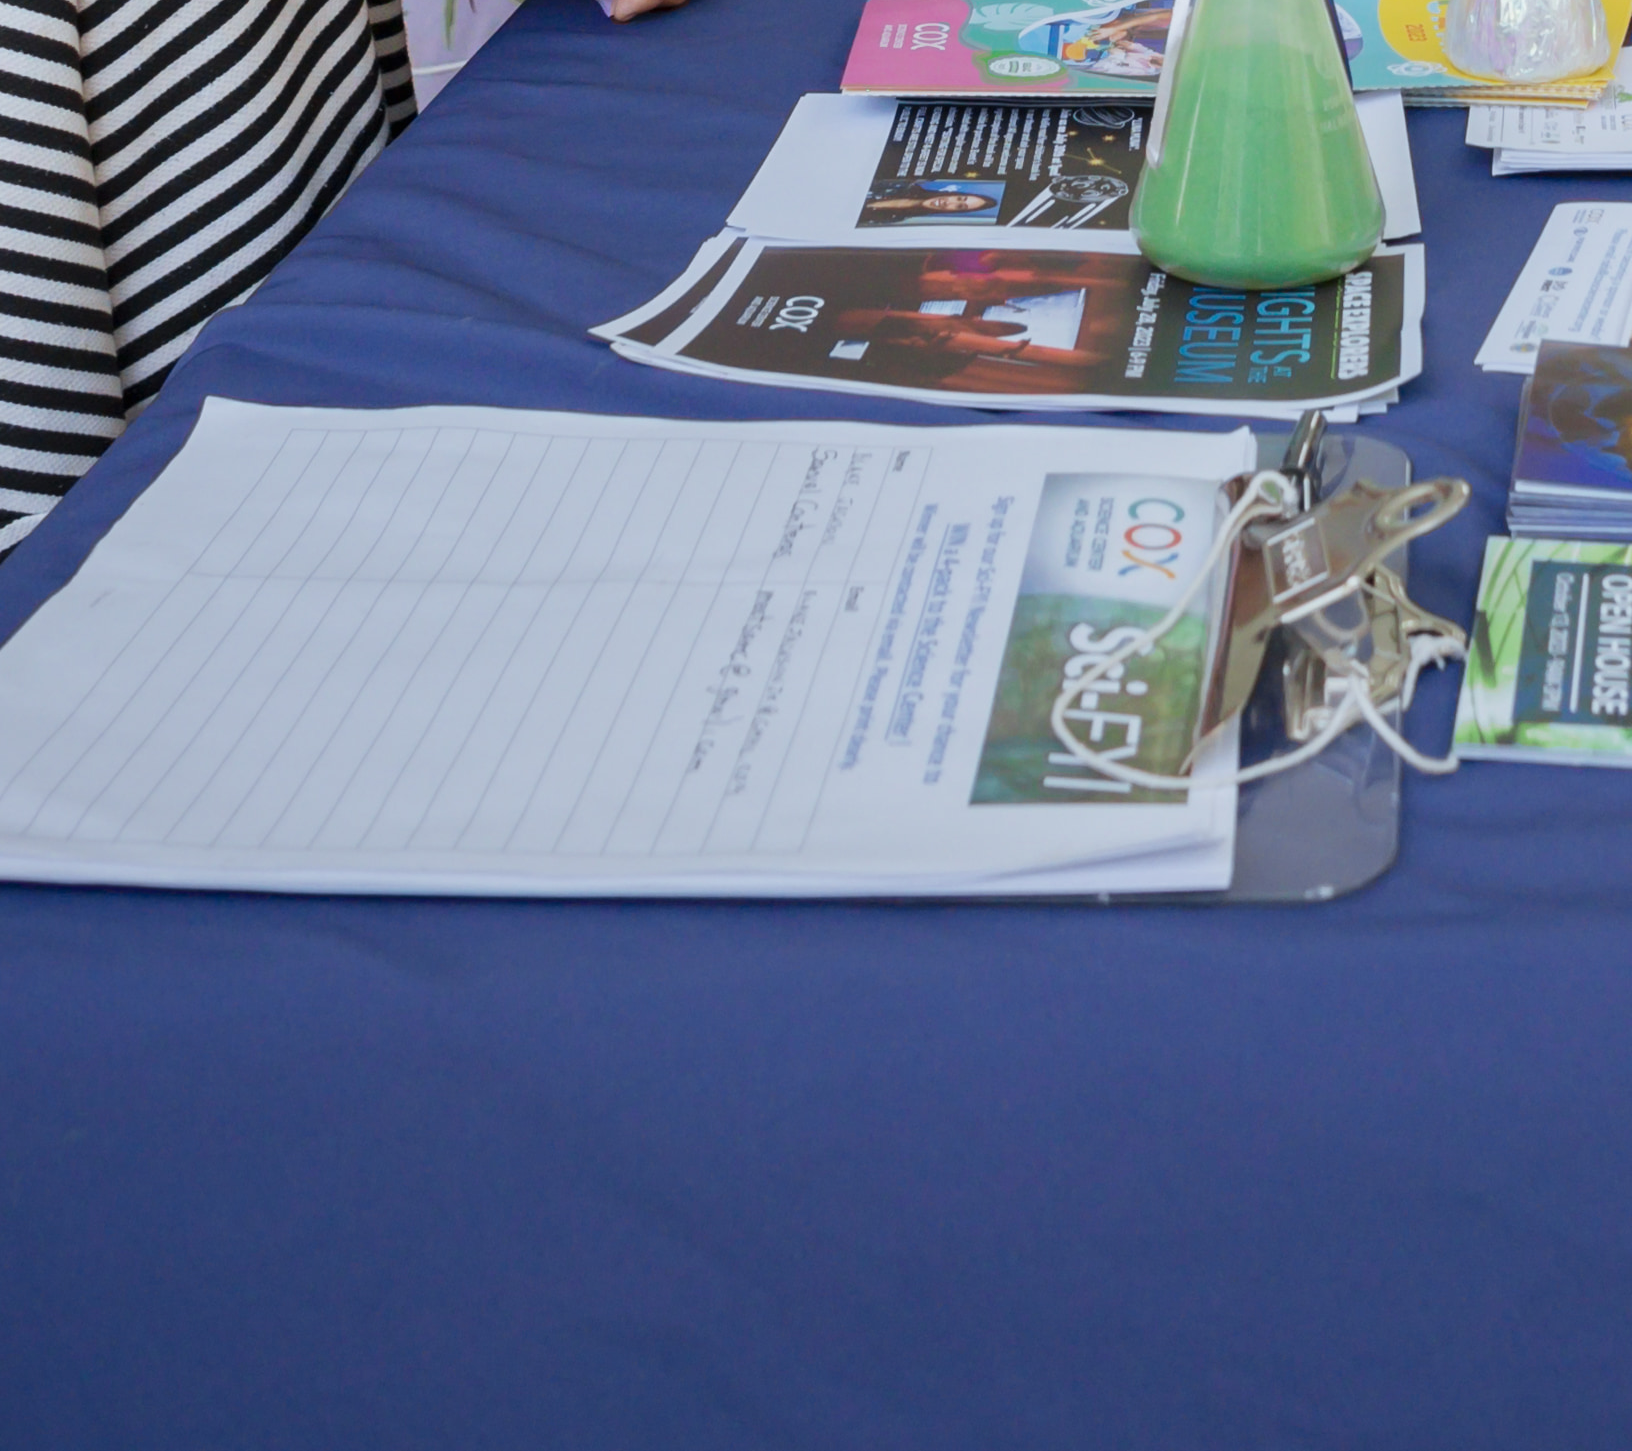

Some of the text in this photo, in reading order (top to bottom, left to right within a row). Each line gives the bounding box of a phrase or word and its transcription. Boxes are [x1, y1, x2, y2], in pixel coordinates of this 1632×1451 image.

[910, 22, 950, 51] COX
[1405, 23, 1429, 42] 2023
[768, 295, 826, 334] COX
[1136, 297, 1161, 312] July
[1132, 326, 1155, 347] 2023
[1337, 270, 1374, 380] SPACE EXPLORERS
[1124, 364, 1145, 379] PM
[1117, 497, 1186, 581] COX
[932, 557, 961, 598] 4-pack
[927, 599, 949, 614] to
[919, 615, 946, 638] the
[953, 605, 987, 667] Newsletter
[904, 639, 939, 689] Science
[1591, 635, 1632, 715] HOUSE
[940, 691, 961, 721] your
[1042, 622, 1156, 794] Sci-FYI
[926, 723, 957, 767] chance
